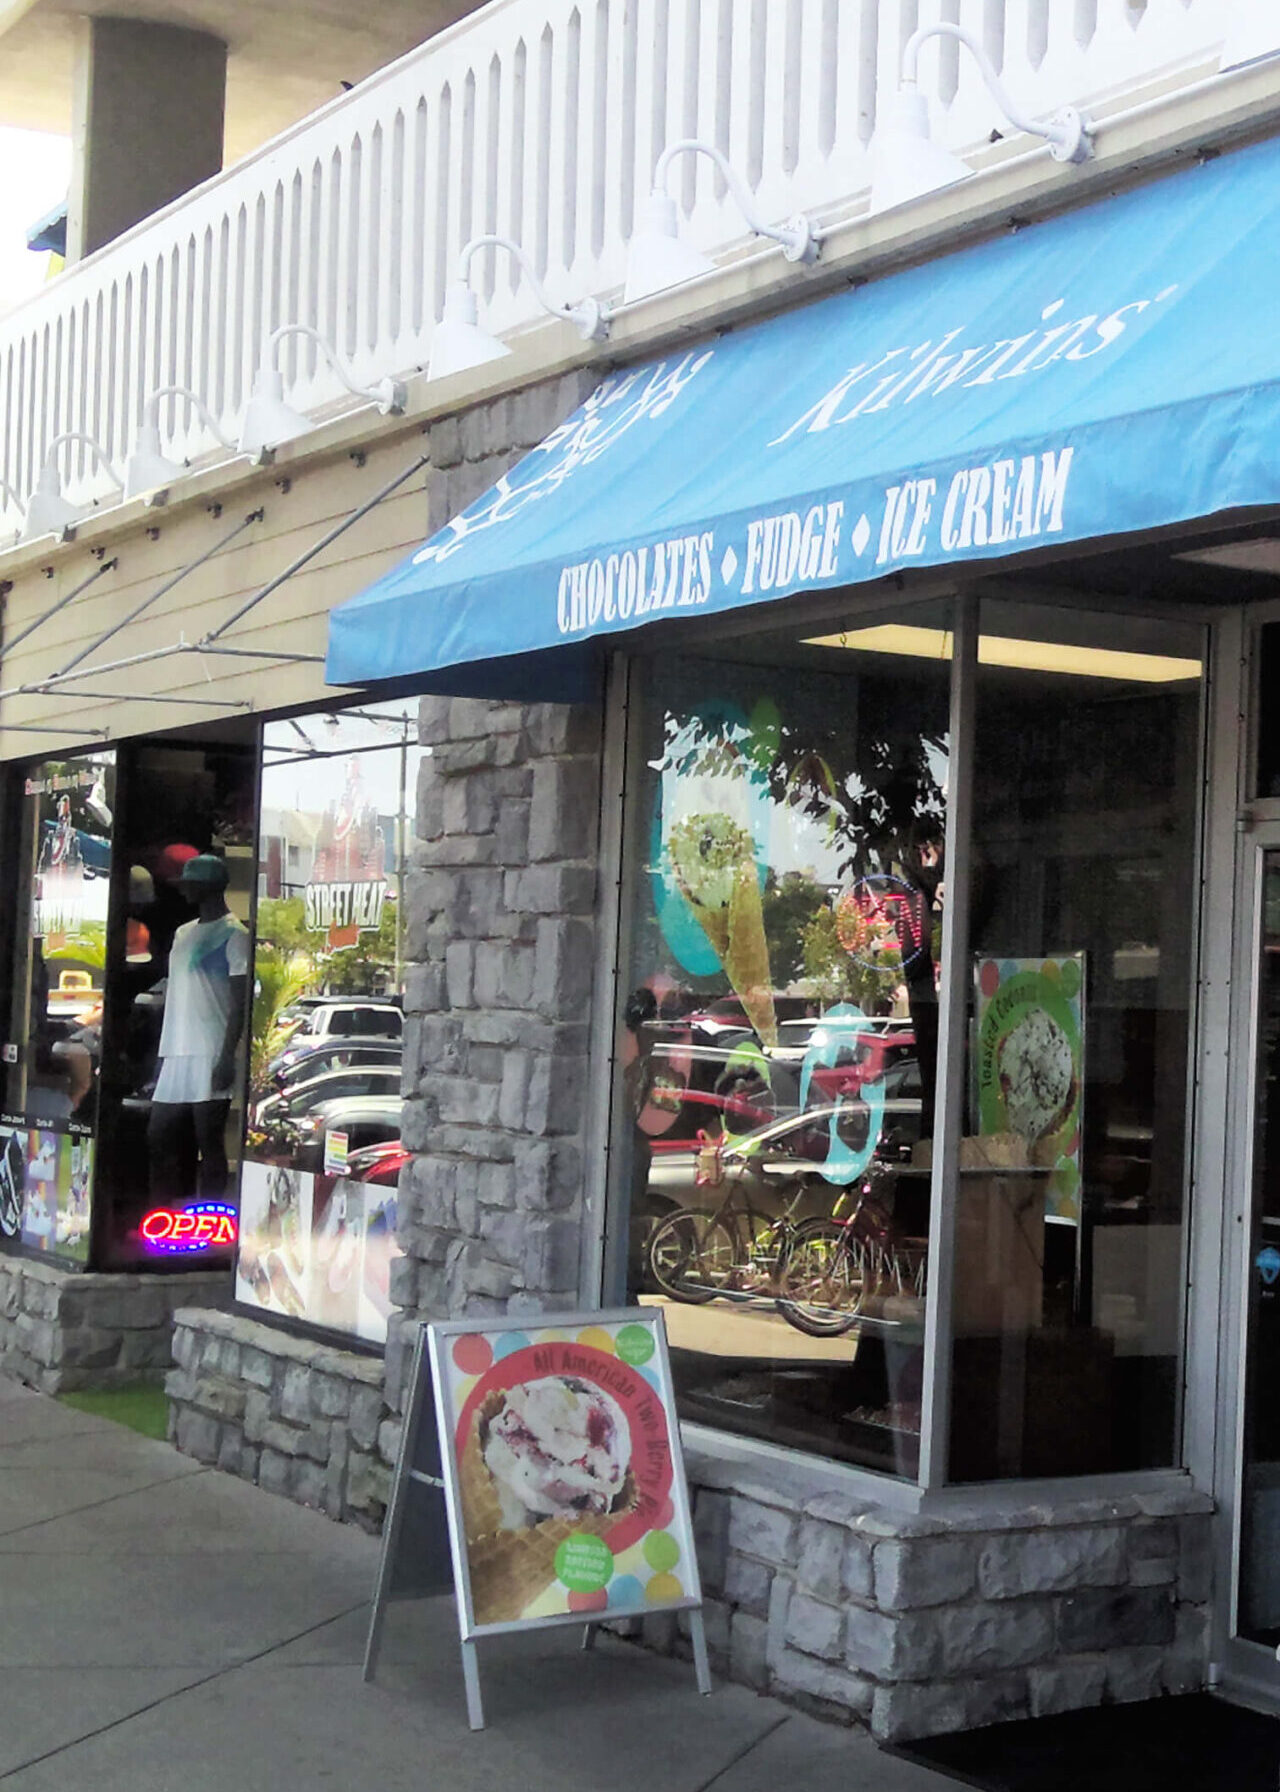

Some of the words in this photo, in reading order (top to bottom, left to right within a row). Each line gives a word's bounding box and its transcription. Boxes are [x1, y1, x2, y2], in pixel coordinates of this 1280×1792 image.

[767, 297, 1152, 447] Kilwins
[557, 531, 714, 634] CHOCOLATES
[740, 501, 844, 594] FUDGE
[875, 477, 936, 565] ICE
[940, 446, 1075, 551] CREAM
[306, 883, 351, 930] STREET
[352, 881, 387, 928] HEAT
[141, 1210, 236, 1243] OPEN
[534, 1349, 554, 1373] All
[562, 1351, 635, 1398] American
